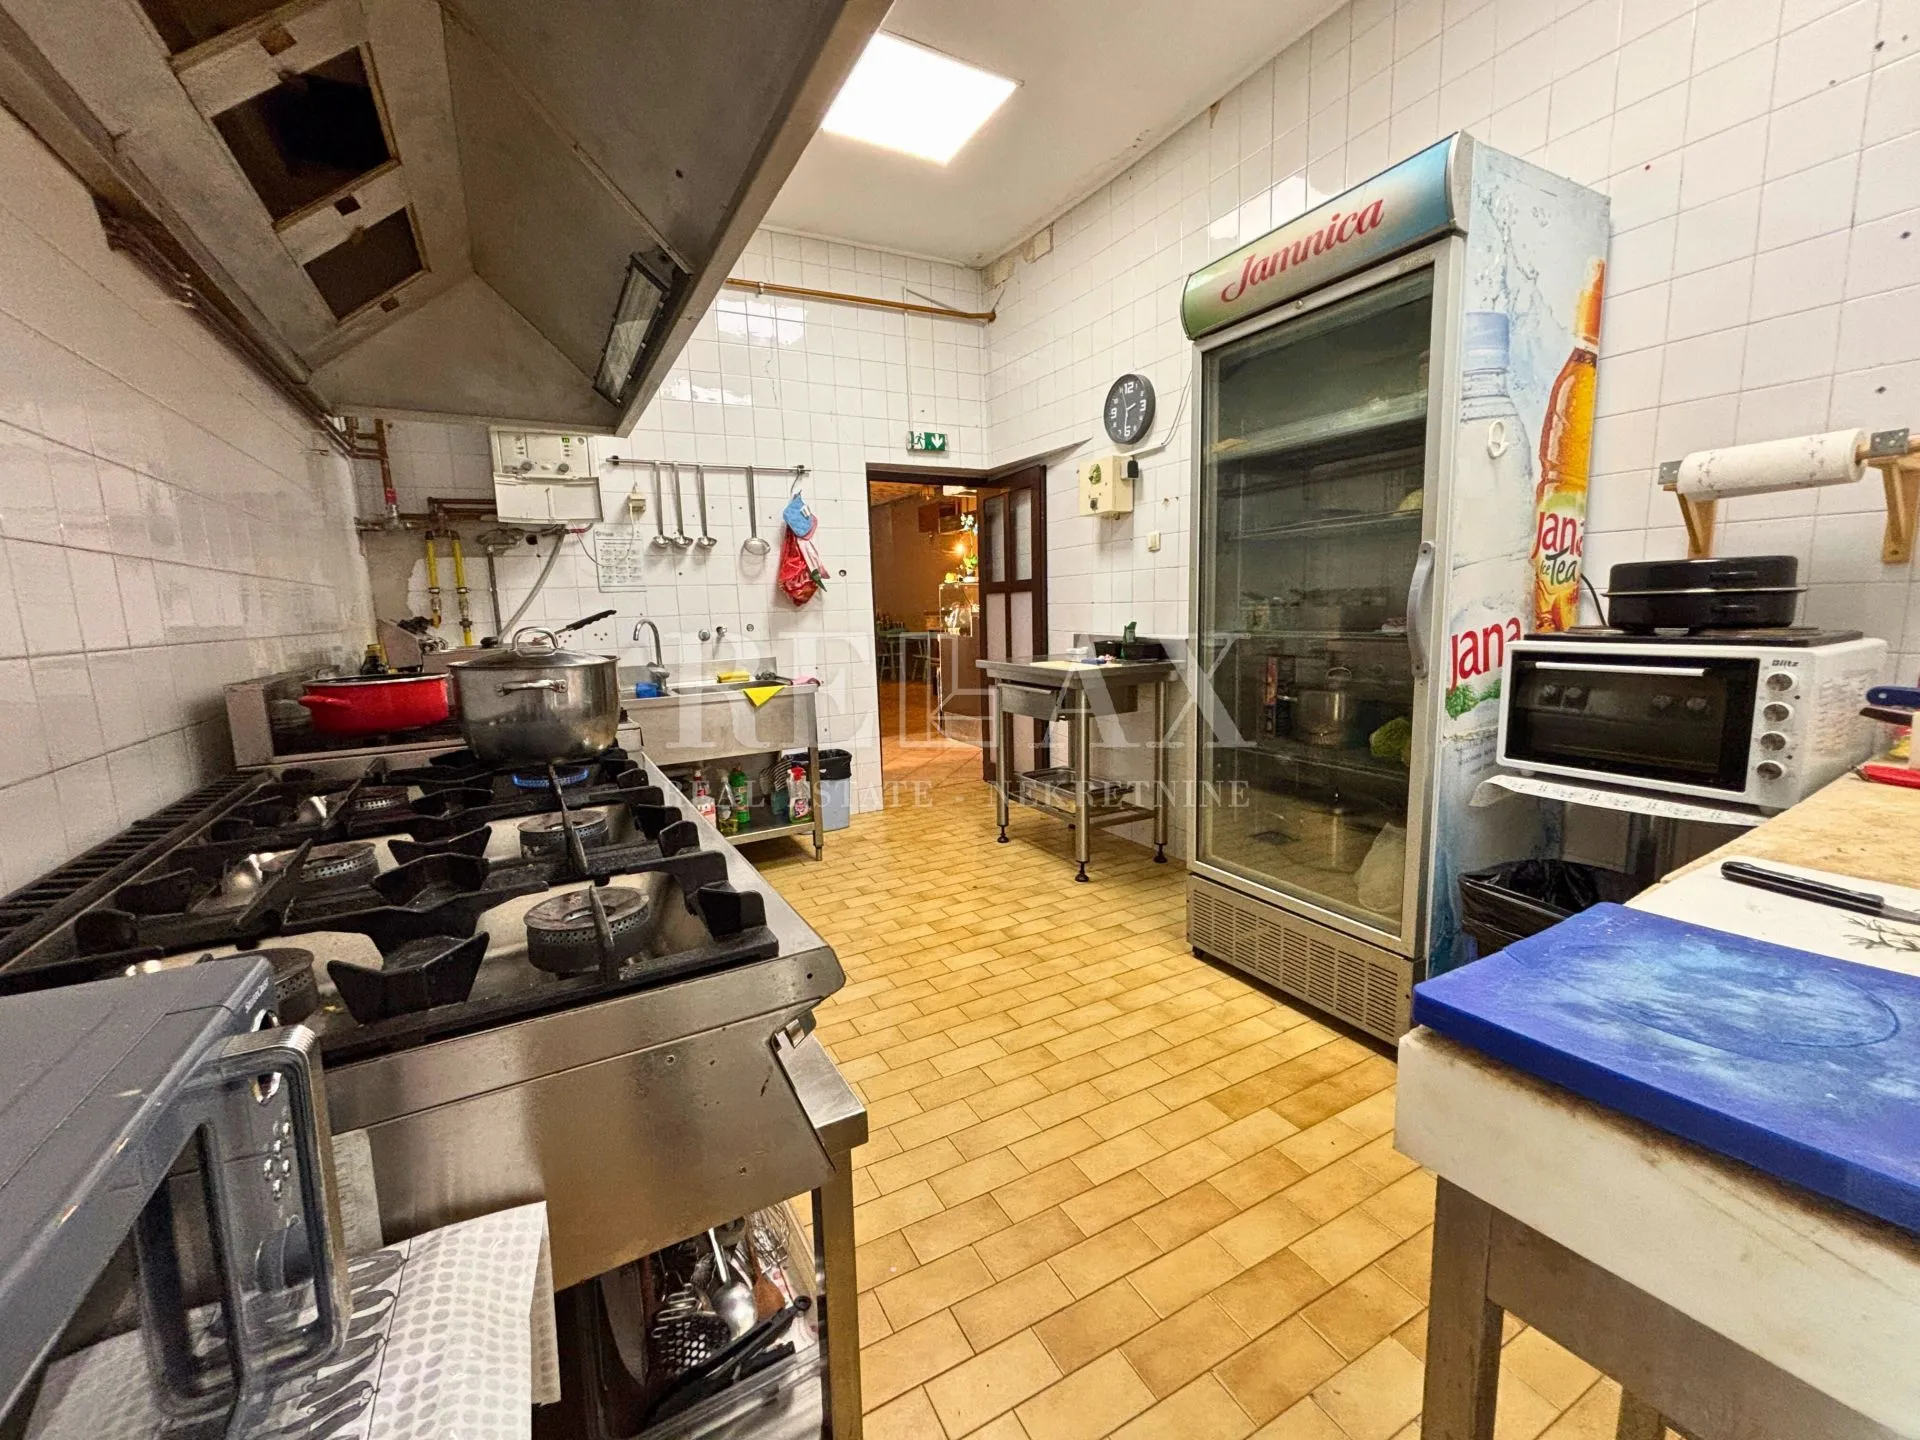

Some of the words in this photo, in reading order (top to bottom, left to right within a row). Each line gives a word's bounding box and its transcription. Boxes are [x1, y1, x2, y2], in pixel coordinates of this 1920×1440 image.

[1220, 199, 1385, 303] Jamnica
[1124, 381, 1134, 394] 12
[1139, 399, 1147, 412] 3
[1109, 407, 1117, 419] 9
[1545, 546, 1578, 586] Tea
